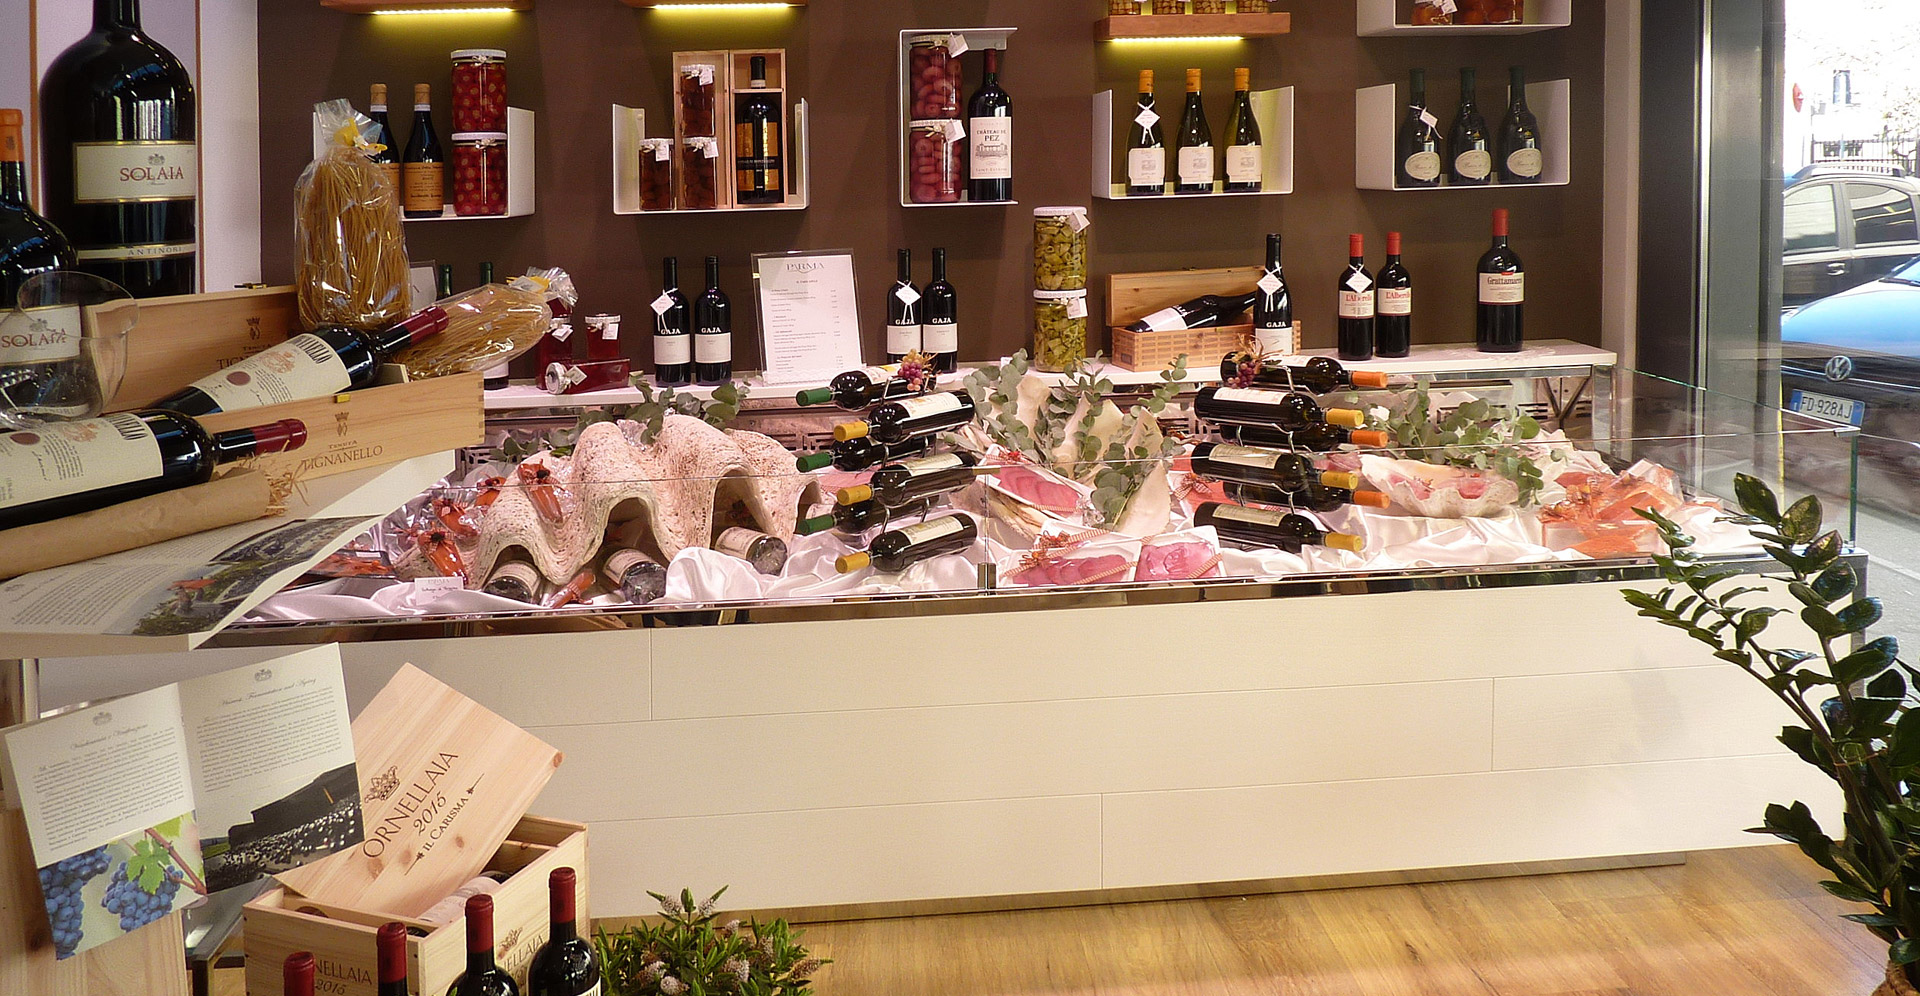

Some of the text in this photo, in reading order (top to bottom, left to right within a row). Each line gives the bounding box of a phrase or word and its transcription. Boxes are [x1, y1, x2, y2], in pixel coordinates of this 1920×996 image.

[984, 134, 1000, 142] PEZ
[119, 166, 184, 181] SOLAIA
[128, 246, 181, 256] ANTINORI
[329, 440, 358, 449] TENUTA
[302, 445, 383, 471] TIGNANELLO
[363, 752, 459, 858] ORNELLAIA
[413, 790, 447, 837] 2015
[422, 797, 469, 852] IL CARISMA
[315, 959, 373, 986] NELLAIA
[315, 978, 347, 996] 2015
